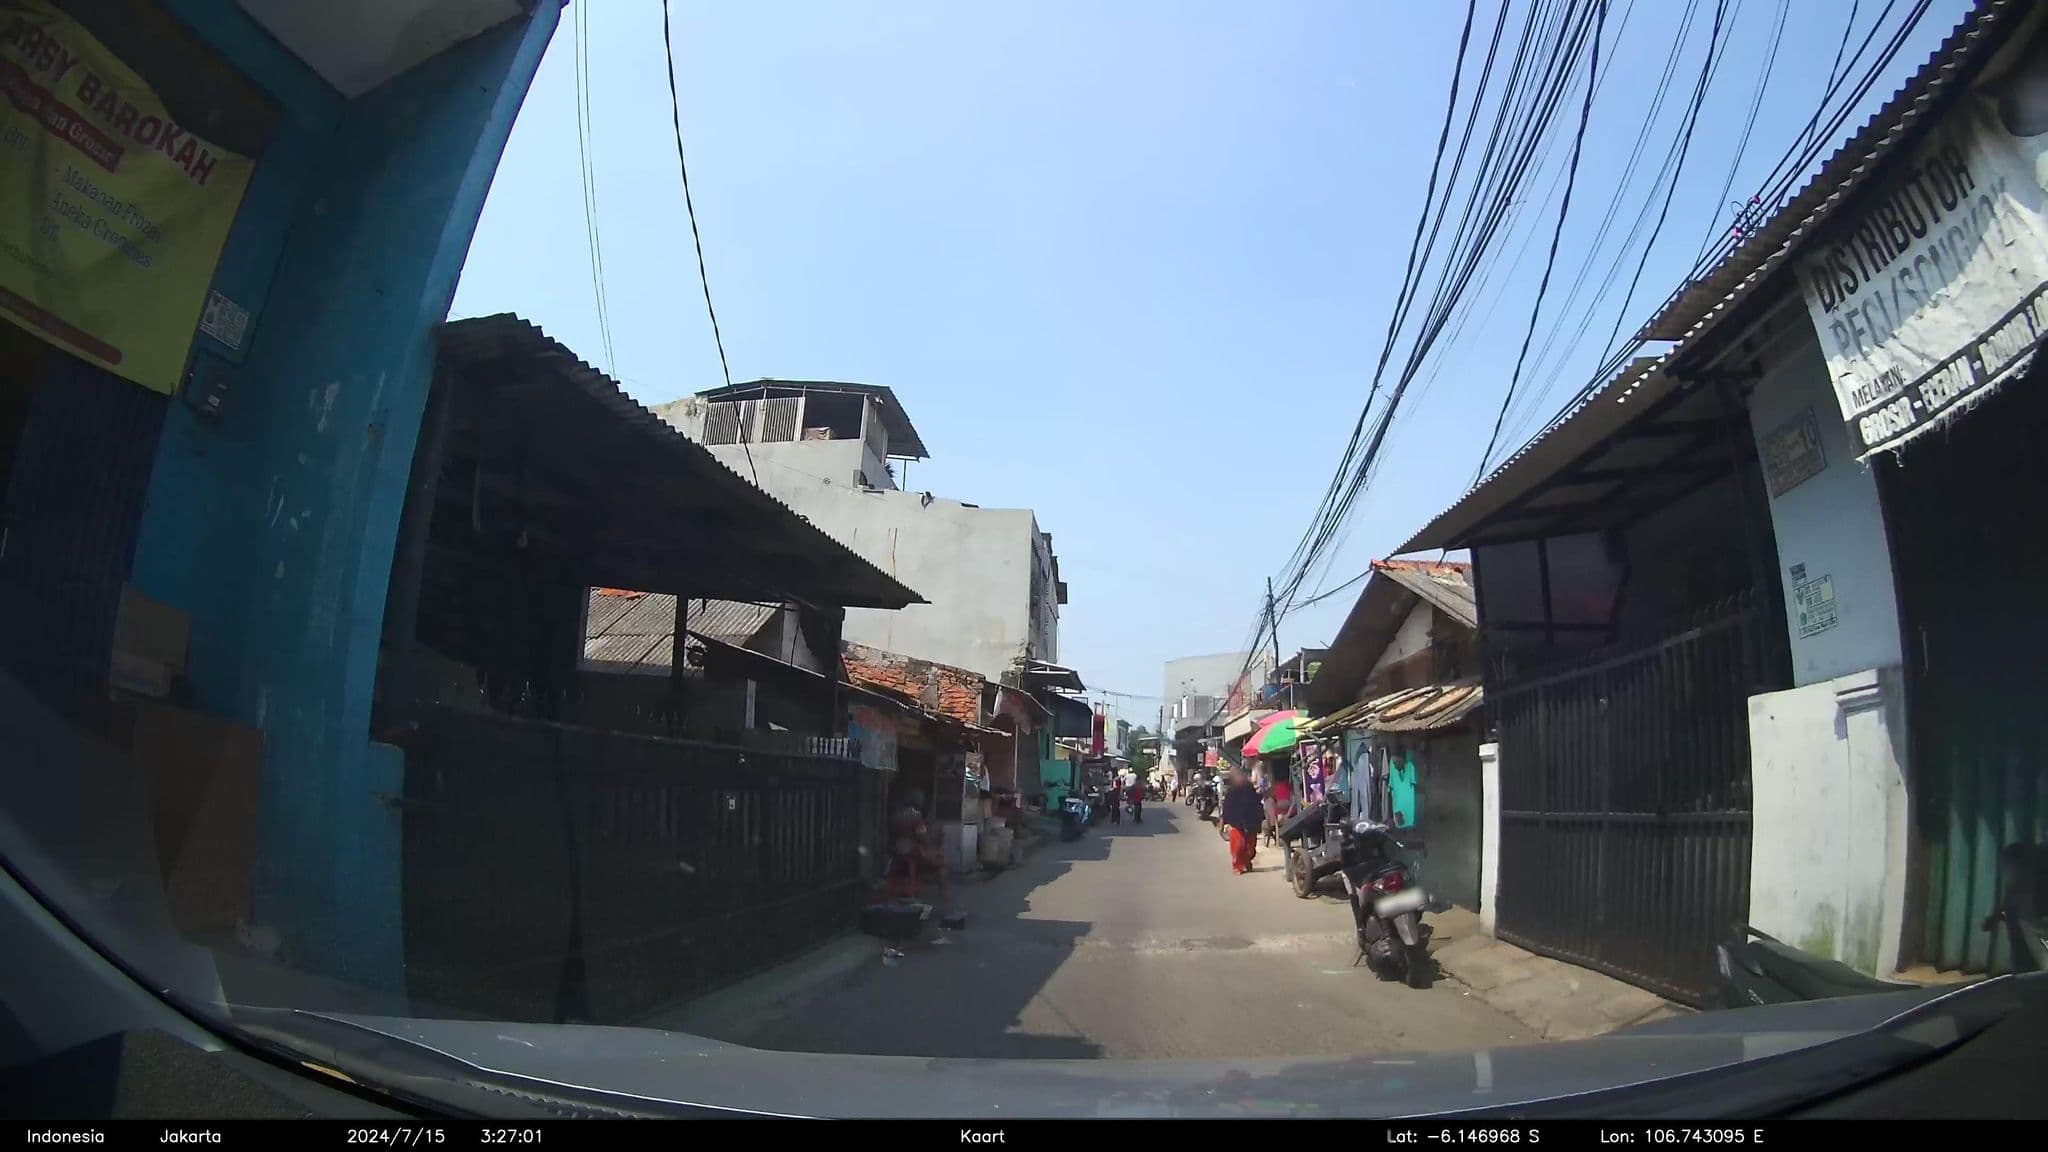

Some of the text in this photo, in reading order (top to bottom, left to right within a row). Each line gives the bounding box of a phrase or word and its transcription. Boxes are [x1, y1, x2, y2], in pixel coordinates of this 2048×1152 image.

[76, 72, 217, 186] BAROKAH
[64, 165, 122, 206] Makanan
[1810, 146, 1975, 315] DISTRIBUTOR
[1858, 396, 1917, 446] GROSIR
